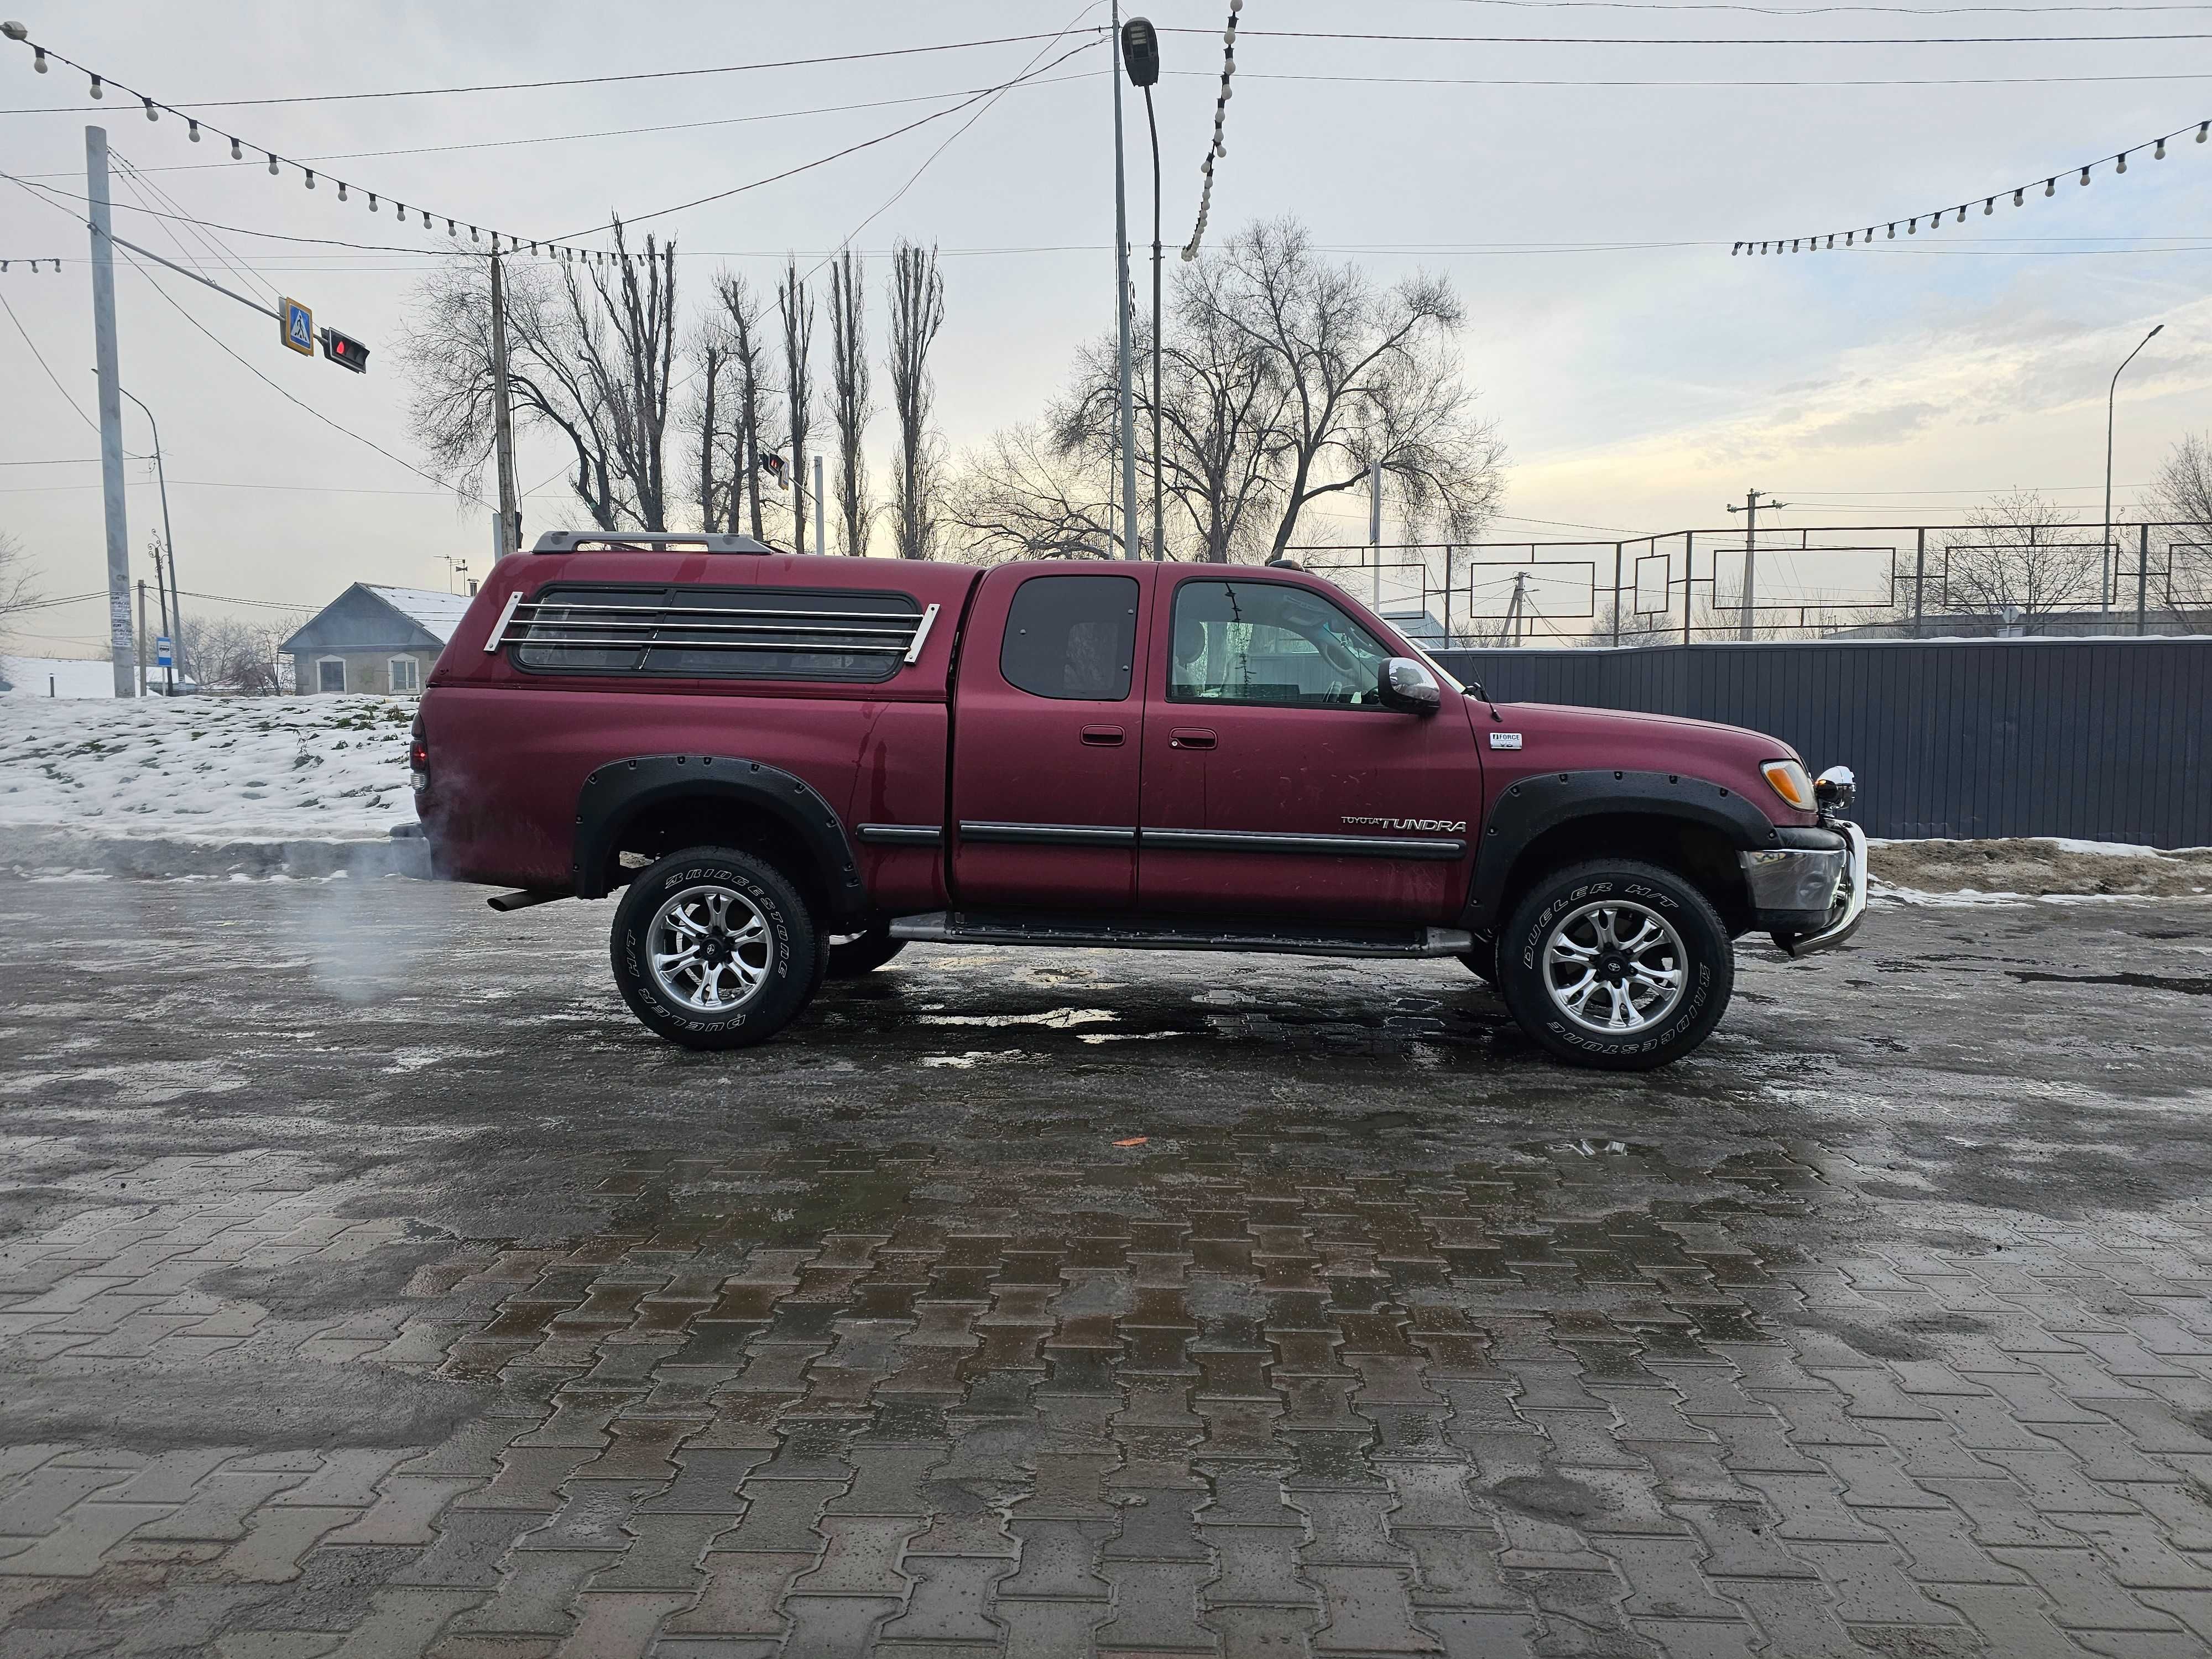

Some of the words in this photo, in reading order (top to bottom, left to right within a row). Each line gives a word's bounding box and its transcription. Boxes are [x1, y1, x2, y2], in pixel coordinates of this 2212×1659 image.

[1380, 818, 1466, 832] TUNDRA
[626, 929, 641, 977] H/T
[665, 869, 789, 978] BRIDGESTONE
[1523, 882, 1613, 969] DUELER
[1625, 884, 1679, 908] H/T
[638, 988, 746, 1032] DUELER
[1547, 962, 1712, 1053] BRIDGESTONE
